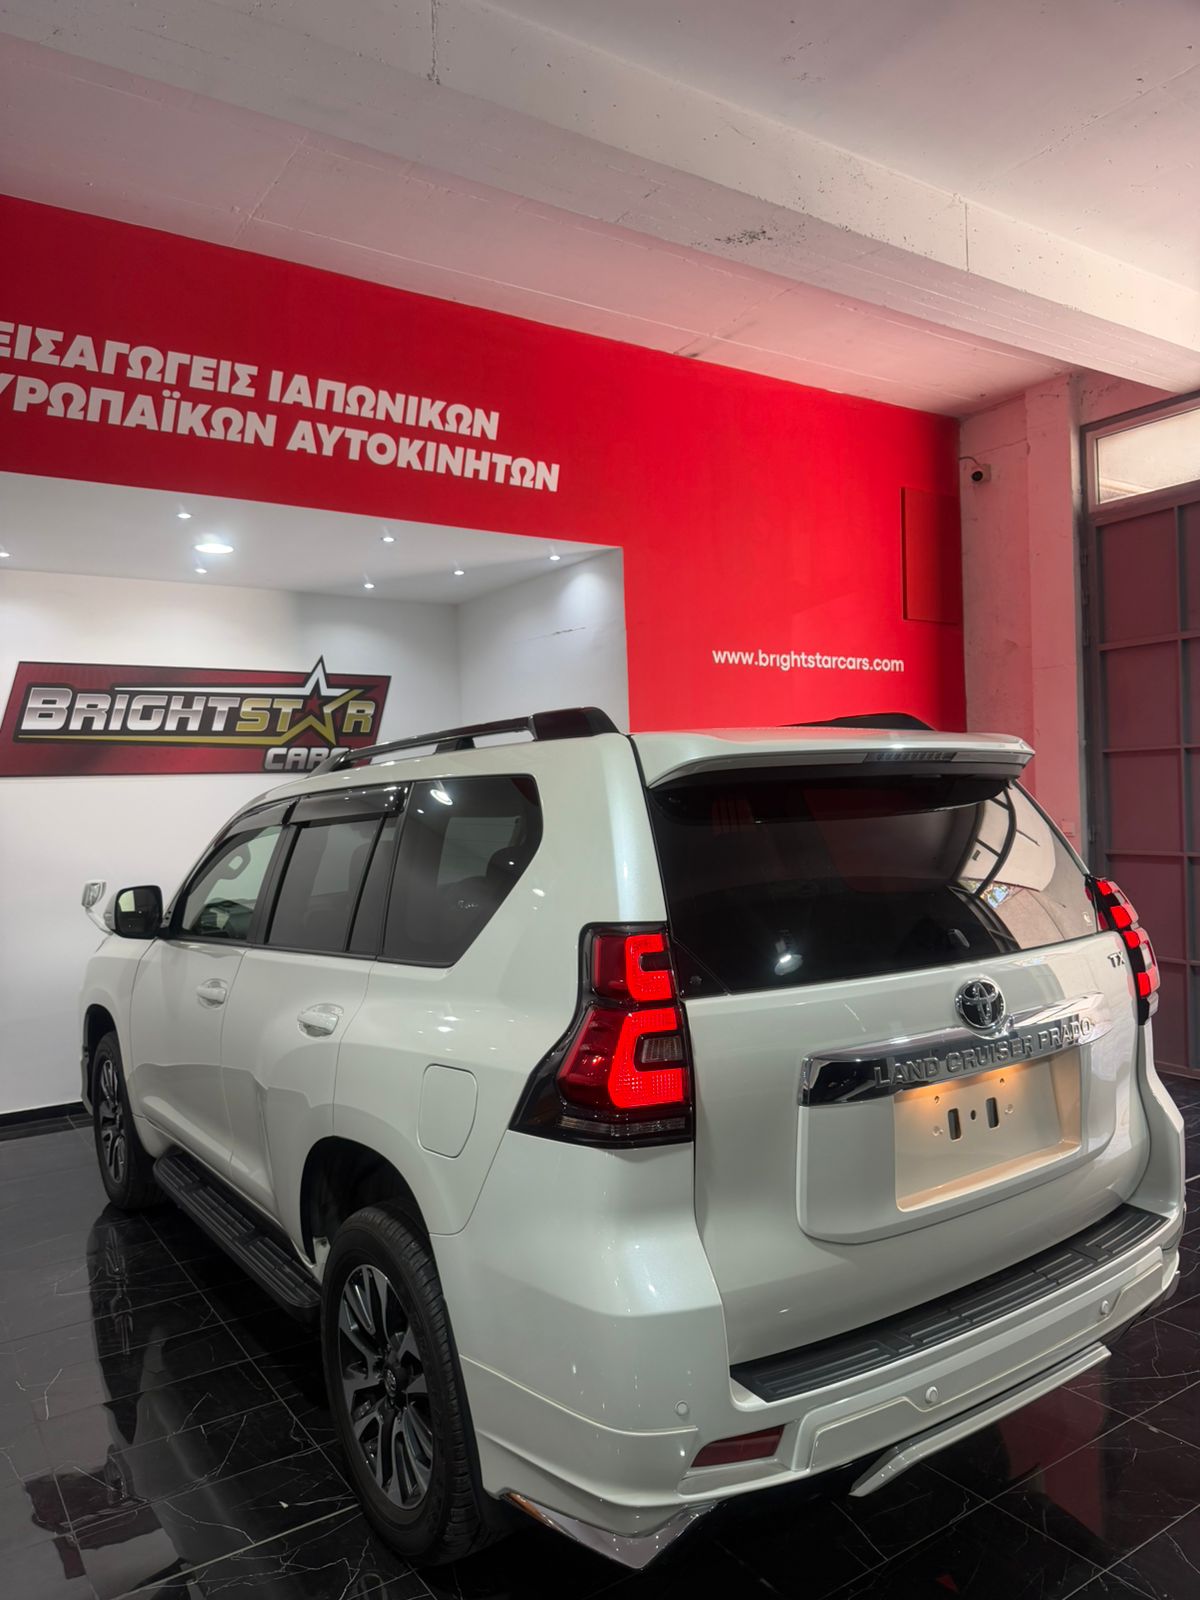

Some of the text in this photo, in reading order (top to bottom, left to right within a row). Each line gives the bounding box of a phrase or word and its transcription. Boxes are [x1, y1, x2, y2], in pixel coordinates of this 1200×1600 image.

[268, 369, 500, 441] ΙΑΠΩΝΙΚΩΝ
[285, 419, 560, 493] ΑΥΤΟΚΙΝΗΤΩΝ
[711, 648, 905, 672] www.brightstarcars.com
[264, 747, 350, 770] CAR
[1107, 951, 1125, 968] TX
[873, 1016, 1095, 1088] LAND CRUISER PRADO
